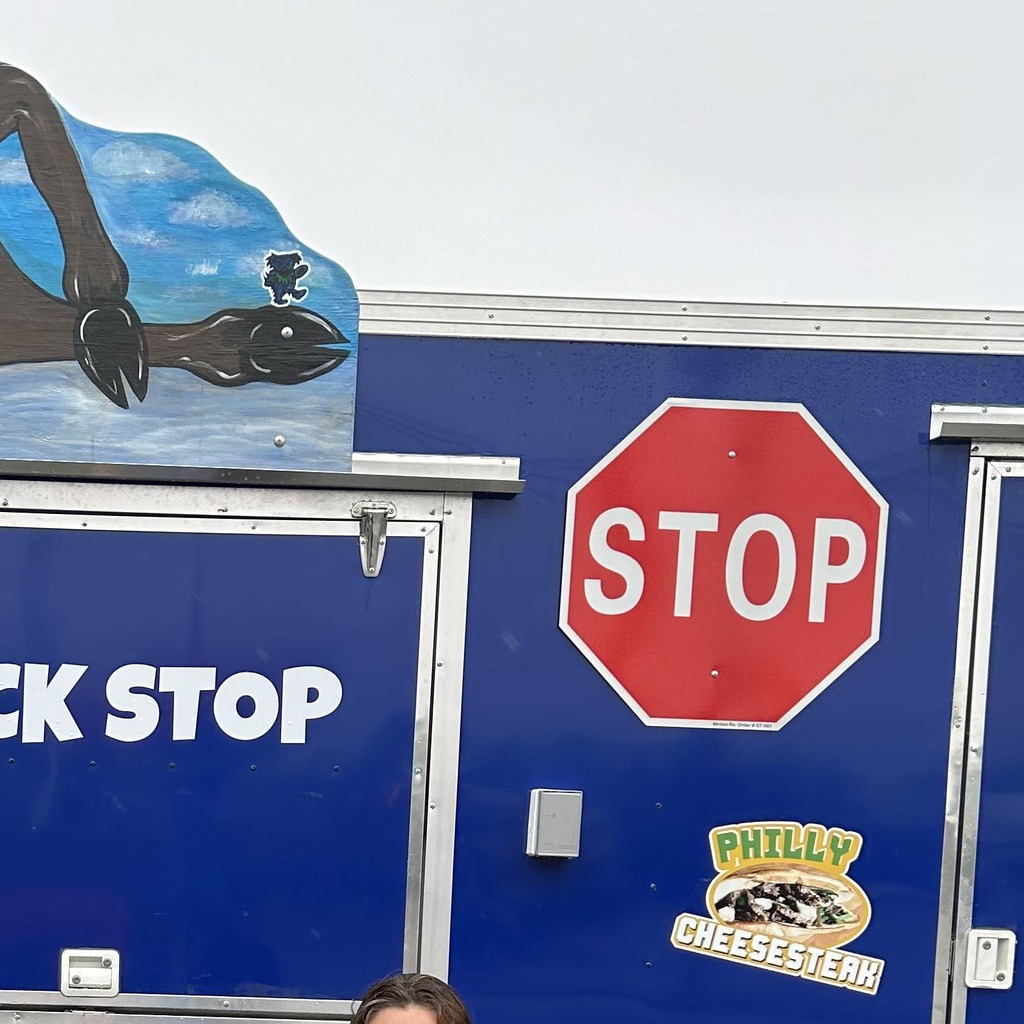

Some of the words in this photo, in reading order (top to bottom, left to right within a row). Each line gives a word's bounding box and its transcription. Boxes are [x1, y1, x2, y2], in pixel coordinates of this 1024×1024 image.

[583, 506, 867, 623] STOP
[105, 663, 343, 744] STOP
[716, 827, 853, 867] PHILLY
[676, 918, 881, 989] CHEESESTEAK
